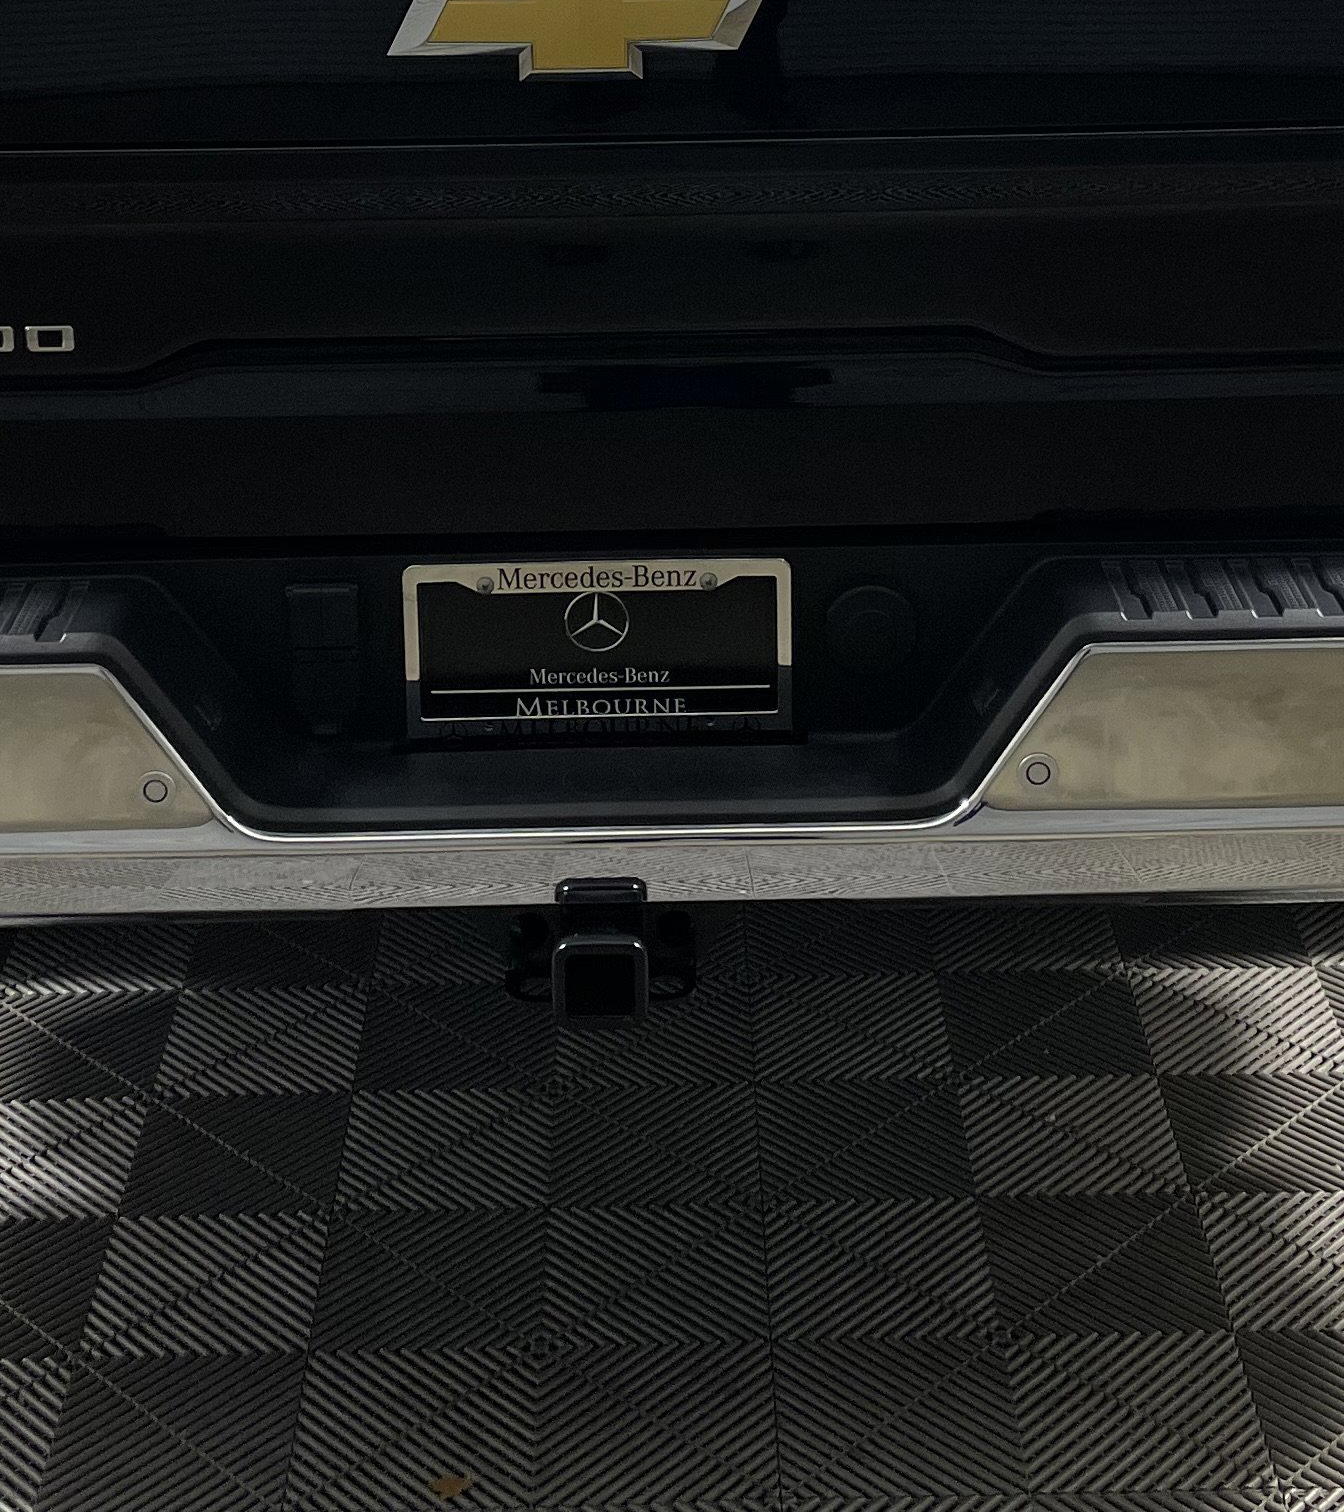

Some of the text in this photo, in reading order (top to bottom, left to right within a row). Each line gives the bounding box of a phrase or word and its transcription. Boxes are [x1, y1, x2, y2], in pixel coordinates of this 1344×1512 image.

[497, 565, 697, 590] Mercedes-Benz
[530, 667, 670, 685] Mercedes-Benz
[515, 696, 687, 717] MELBOURNE
